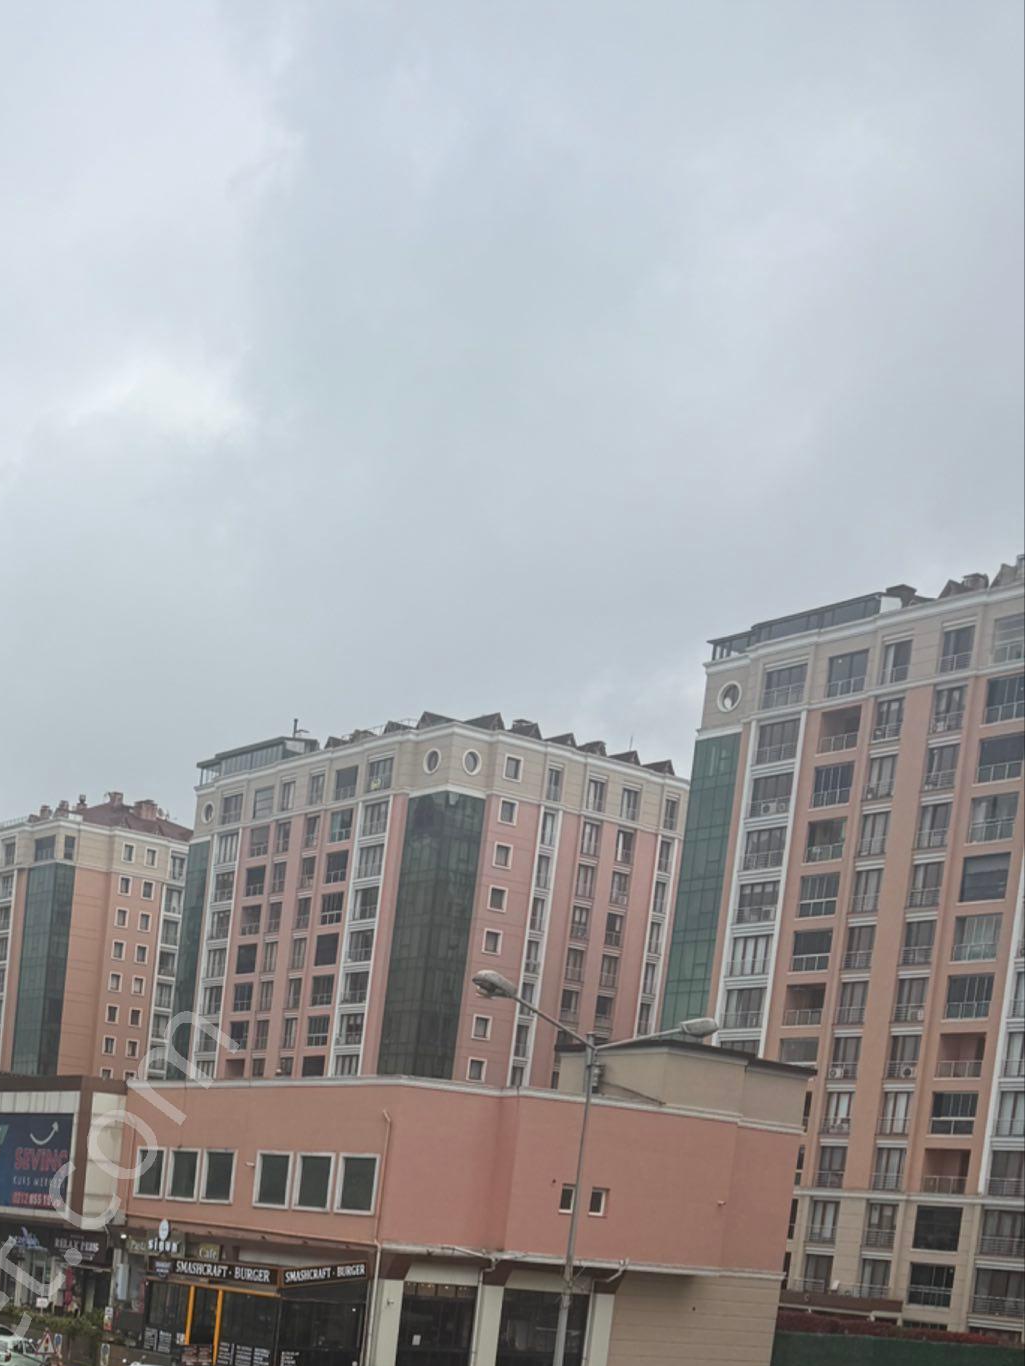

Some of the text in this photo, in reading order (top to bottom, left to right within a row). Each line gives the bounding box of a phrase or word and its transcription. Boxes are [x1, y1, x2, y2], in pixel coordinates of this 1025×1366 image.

[176, 1260, 229, 1278] SMASHCRAFT
[234, 1266, 271, 1283] BURGER
[285, 1263, 366, 1283] SMASHCRAFT BURGER
